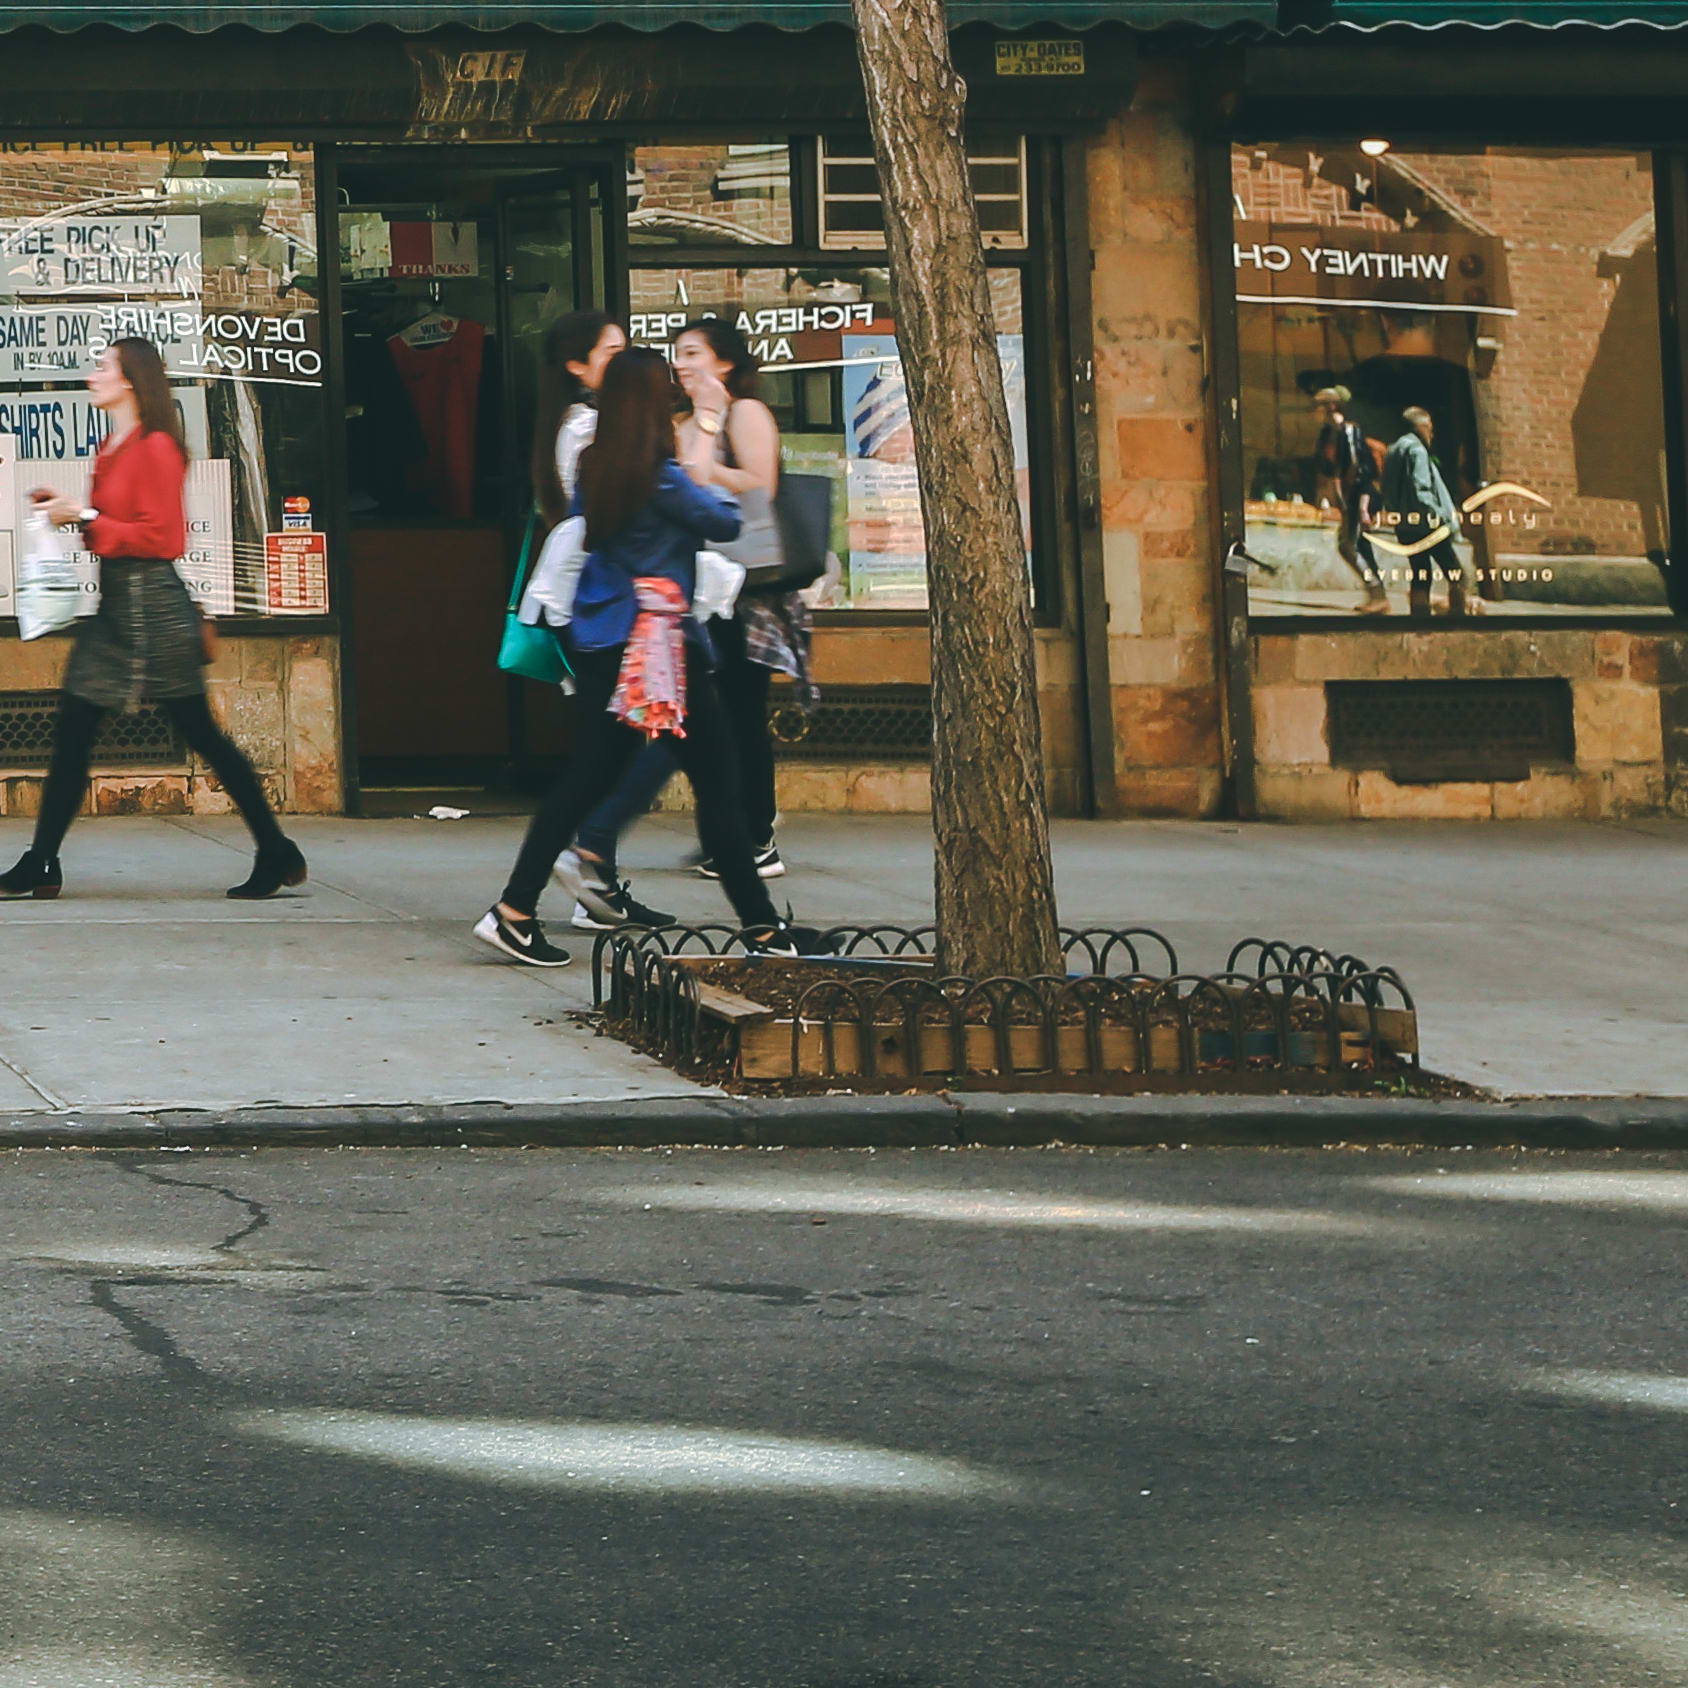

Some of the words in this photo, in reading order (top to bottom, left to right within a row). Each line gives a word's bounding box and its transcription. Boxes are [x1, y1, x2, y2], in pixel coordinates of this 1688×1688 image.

[67, 225, 122, 254] PICK
[134, 224, 166, 254] UP
[35, 257, 52, 287] &
[63, 255, 180, 285] DELIVERY
[398, 264, 471, 274] THANKS
[57, 314, 90, 347] DAY
[13, 352, 24, 371] IN
[28, 351, 42, 370] BY
[1373, 511, 1441, 529] joey
[1451, 509, 1536, 529] healy
[1363, 567, 1463, 583] EYEBROW
[1476, 568, 1554, 583] STUDIO
